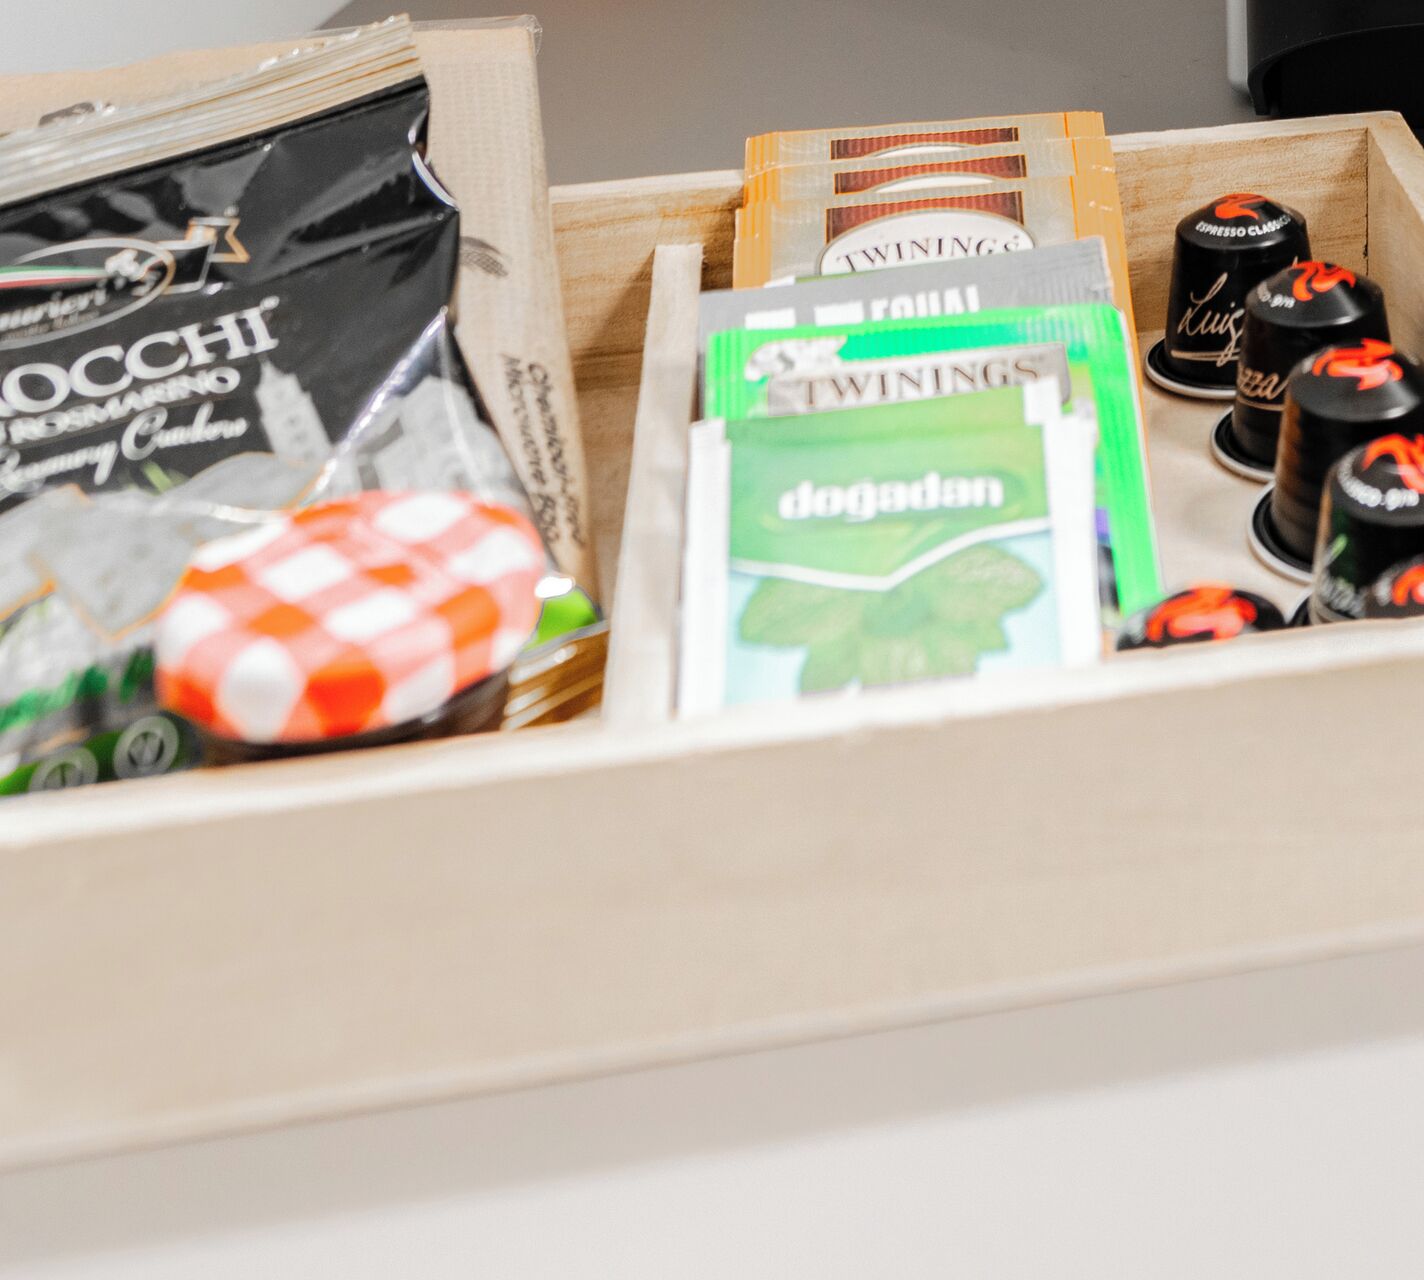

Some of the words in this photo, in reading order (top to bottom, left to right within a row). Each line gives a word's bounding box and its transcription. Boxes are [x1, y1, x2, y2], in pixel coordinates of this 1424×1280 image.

[1195, 221, 1246, 237] ESPRESSO
[0, 305, 279, 416] OCCHI
[802, 357, 1040, 407] TWININGS
